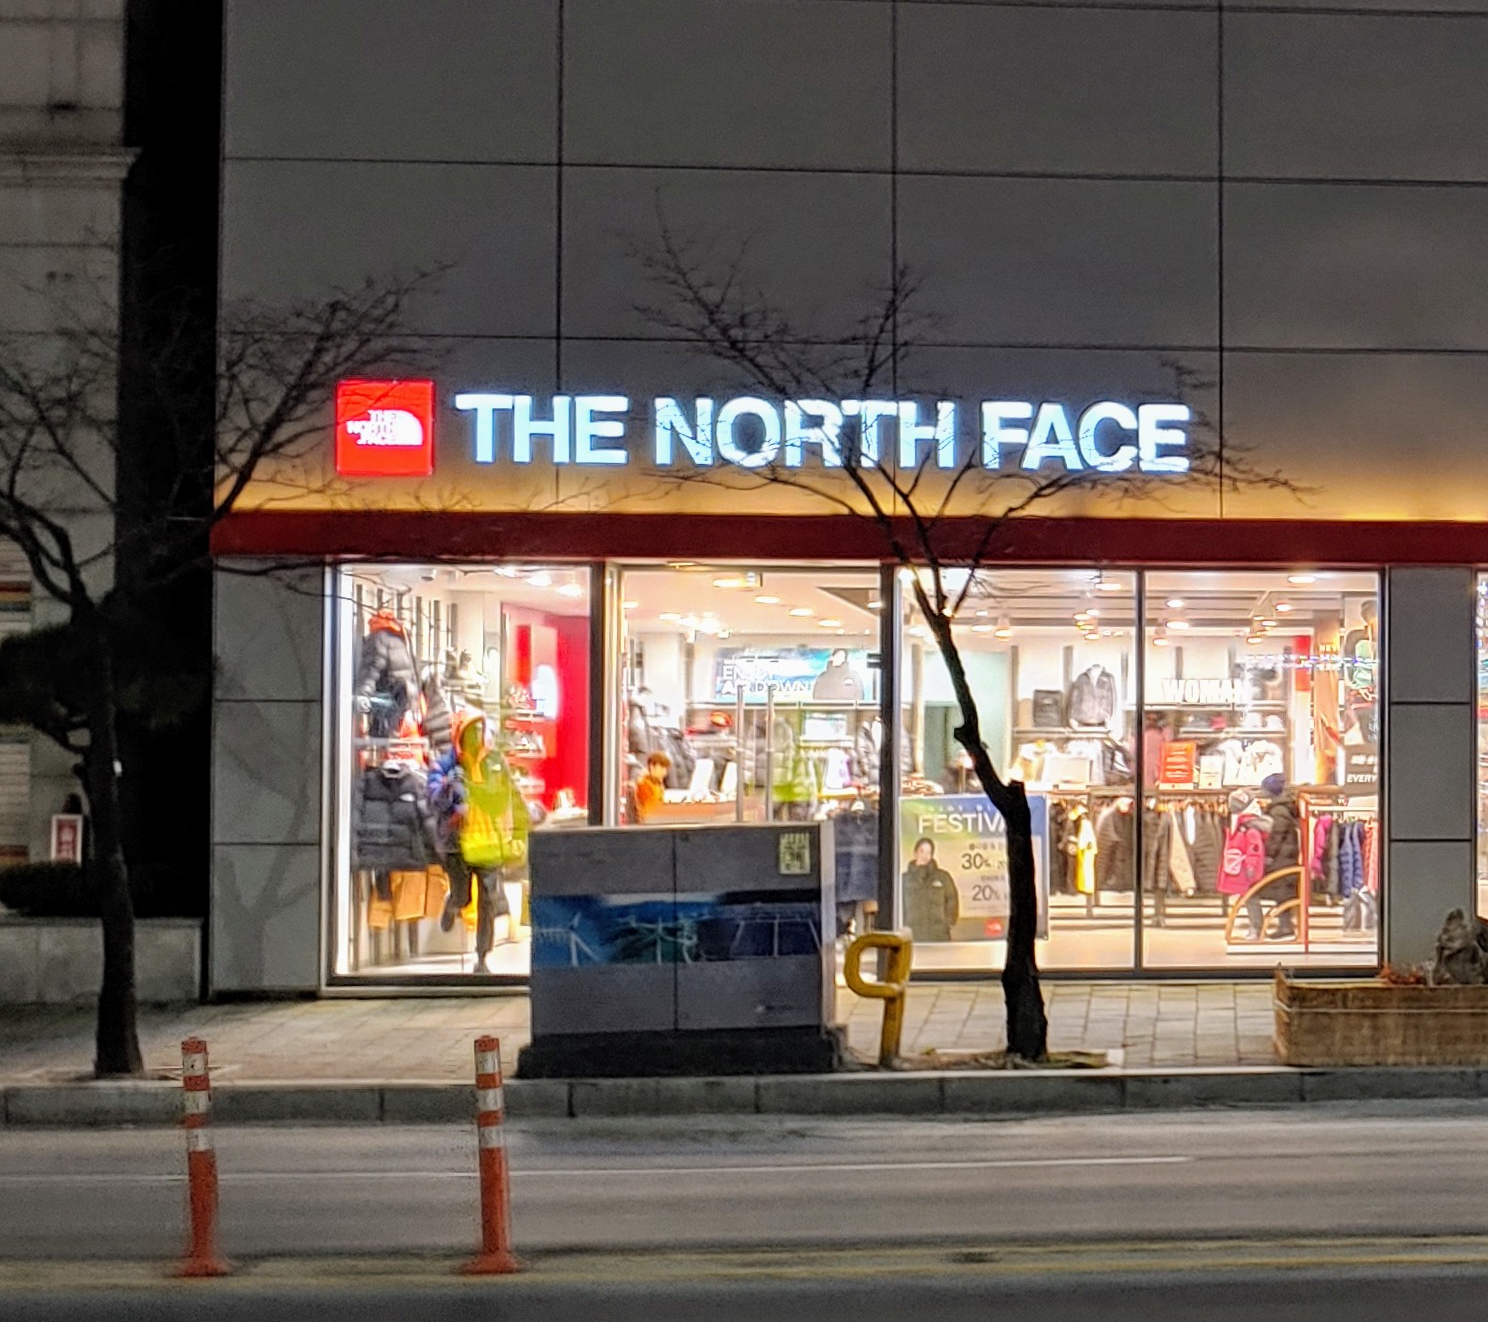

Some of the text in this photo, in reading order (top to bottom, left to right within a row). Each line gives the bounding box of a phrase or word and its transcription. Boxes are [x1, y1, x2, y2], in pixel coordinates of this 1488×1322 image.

[454, 393, 1190, 473] THE NORTH FACE
